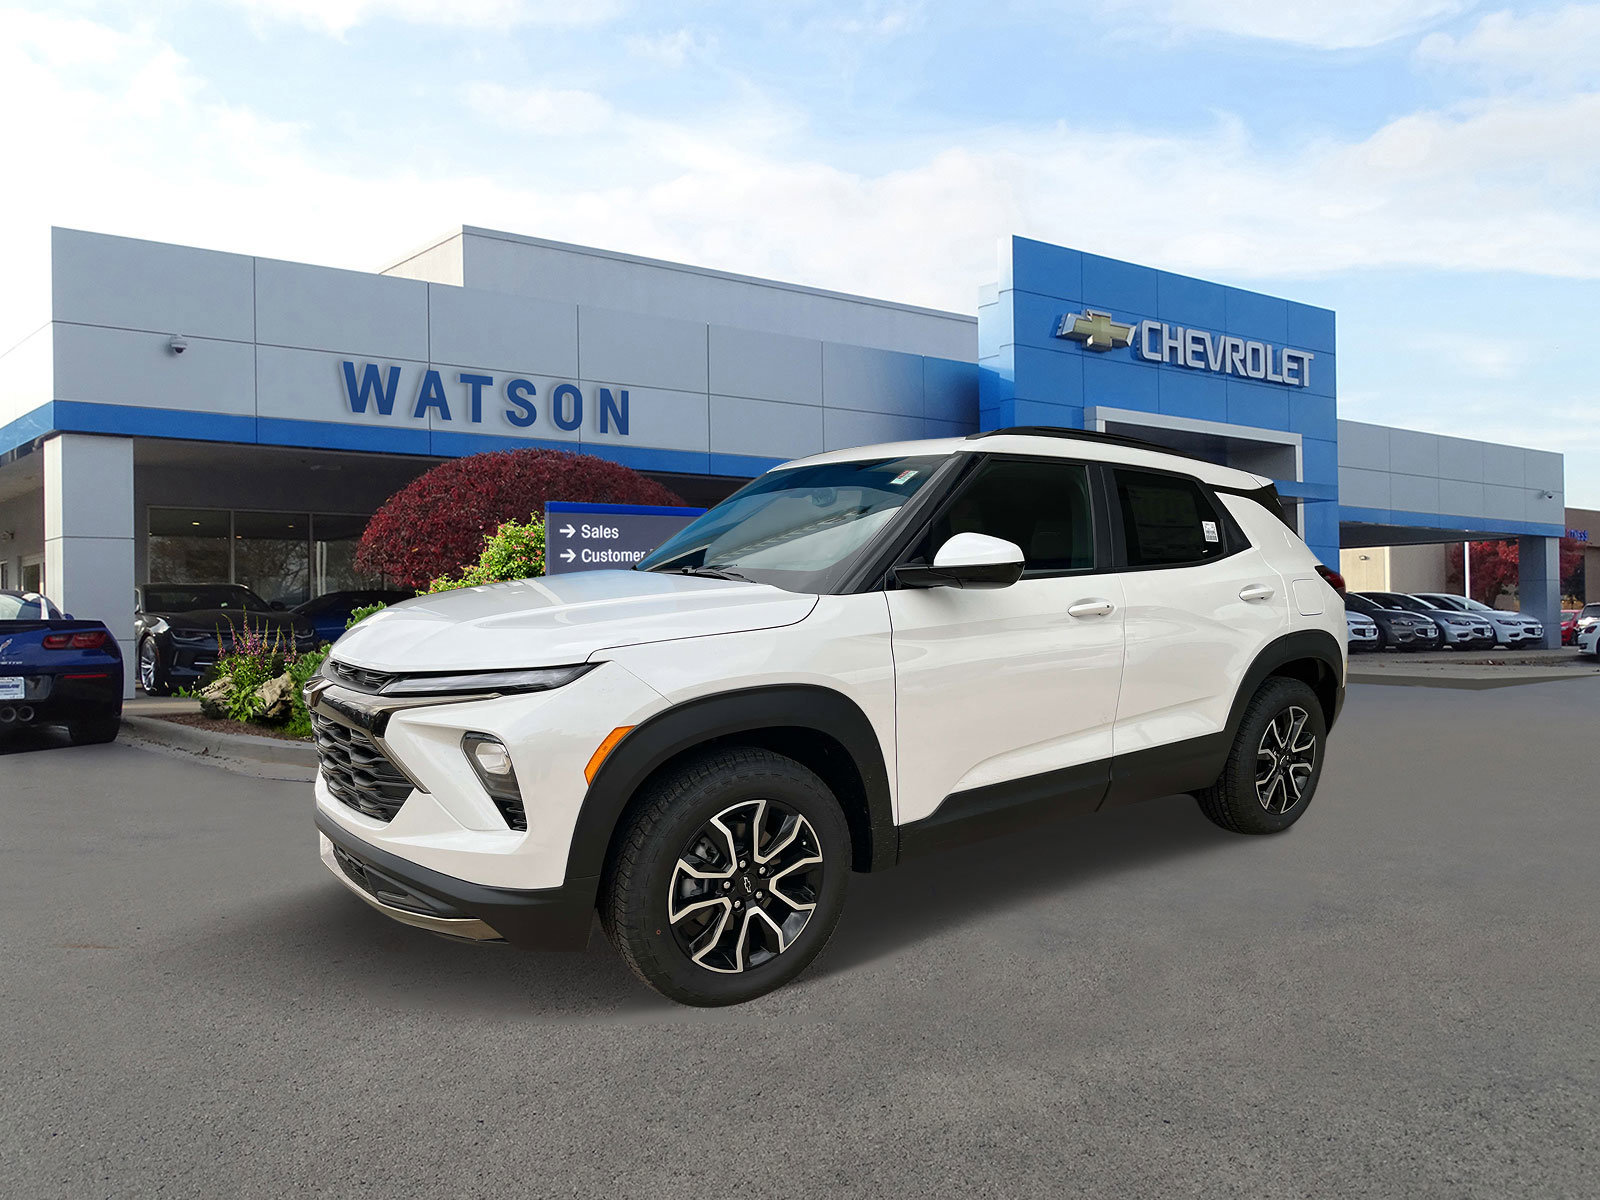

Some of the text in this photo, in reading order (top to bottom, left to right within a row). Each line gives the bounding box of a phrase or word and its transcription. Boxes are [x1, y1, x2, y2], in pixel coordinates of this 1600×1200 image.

[1140, 319, 1315, 387] CHEVROLET
[341, 360, 630, 436] WATSON
[581, 524, 620, 539] Sales
[581, 548, 646, 563] Customer
